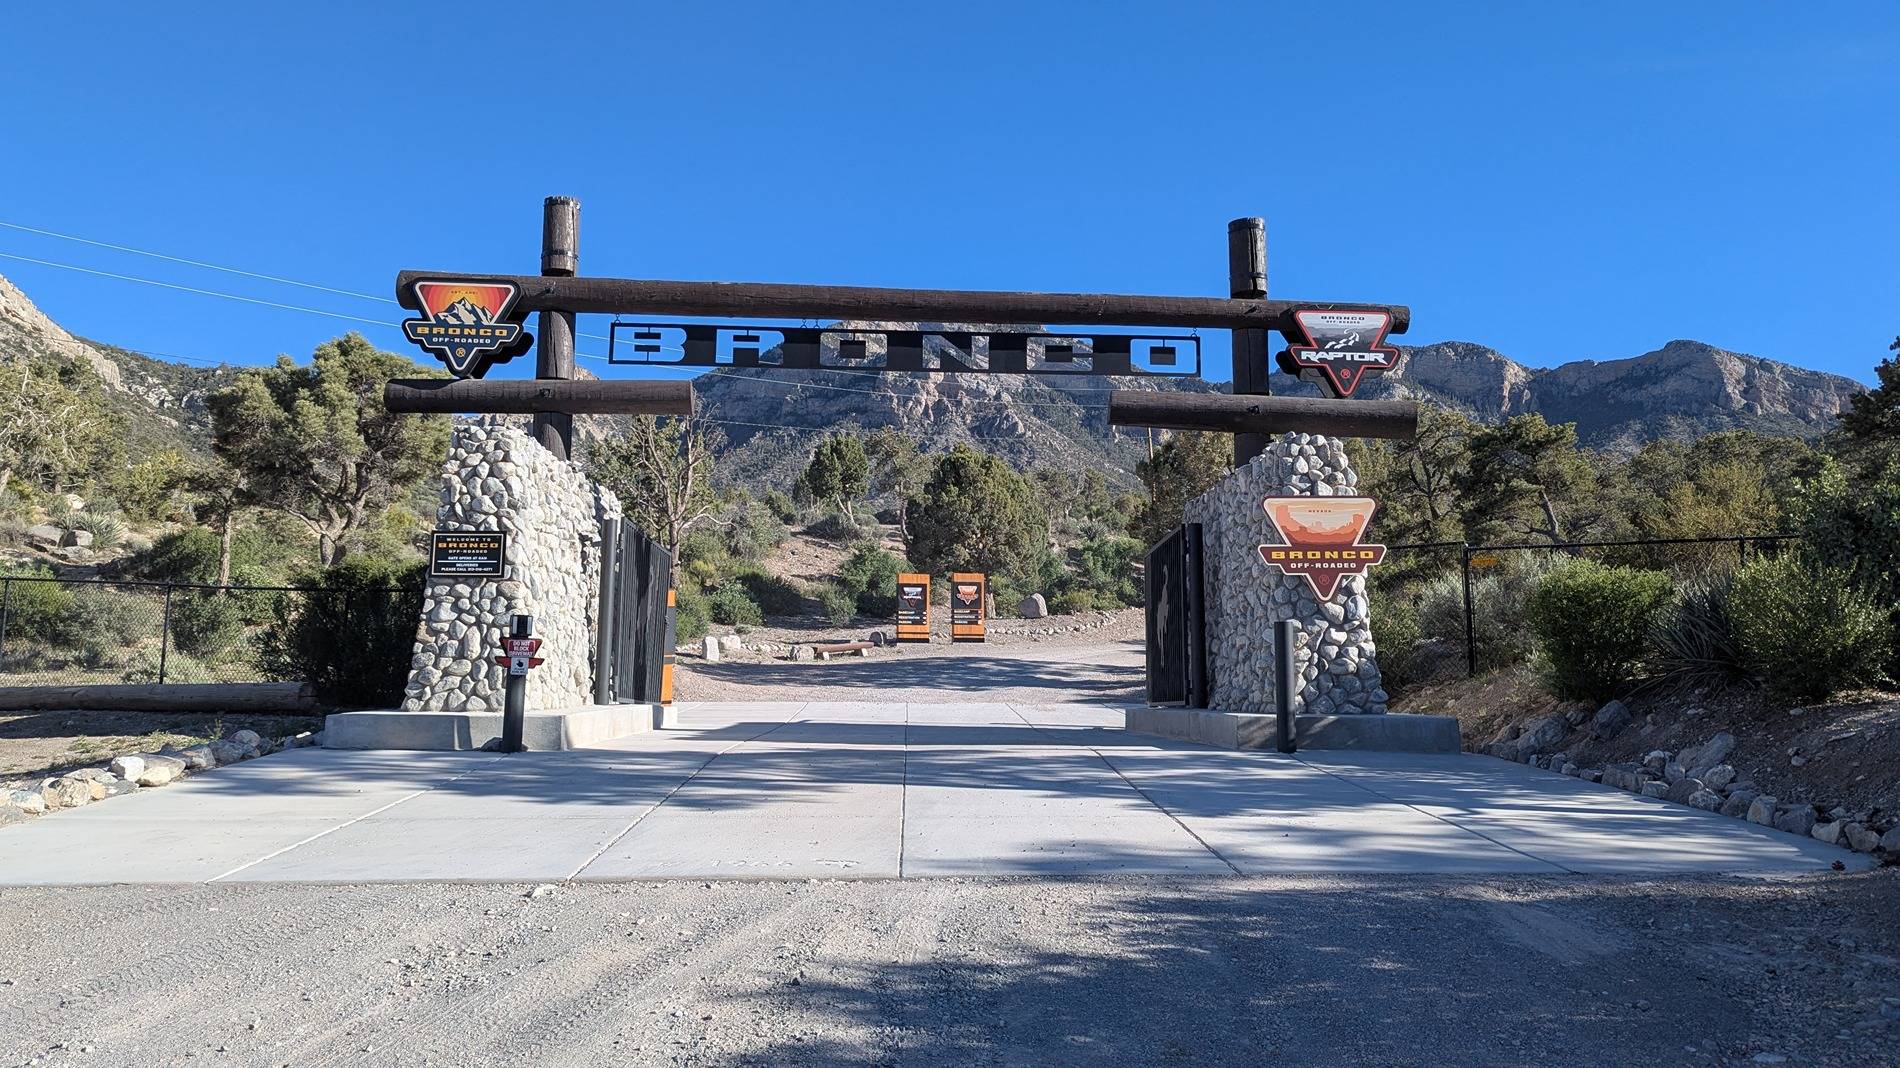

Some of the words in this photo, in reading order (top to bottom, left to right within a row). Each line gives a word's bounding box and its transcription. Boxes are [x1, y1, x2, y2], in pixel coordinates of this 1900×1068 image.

[416, 326, 508, 337] BRONCO
[612, 326, 1198, 374] BRONCO
[1301, 351, 1388, 365] RAPTOR
[1271, 550, 1374, 560] BRONCO
